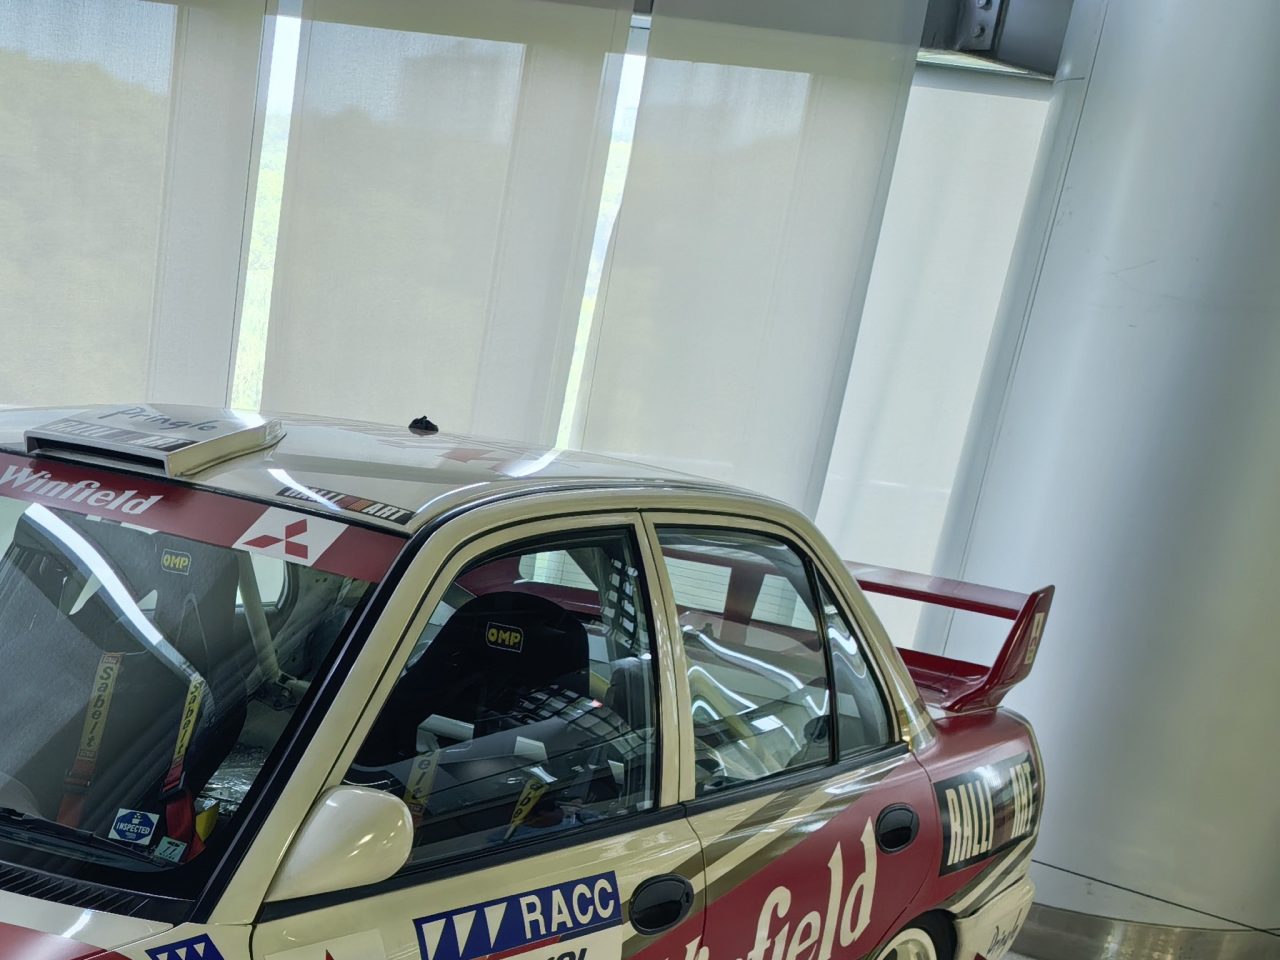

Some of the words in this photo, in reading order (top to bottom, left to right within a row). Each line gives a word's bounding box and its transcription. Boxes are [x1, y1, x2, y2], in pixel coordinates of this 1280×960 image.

[98, 406, 218, 431] Pringle
[163, 553, 189, 570] OMP
[487, 628, 521, 646] OMP
[86, 666, 113, 748] Sabelt
[116, 822, 150, 835] INSPECTED
[945, 777, 994, 866] RALLI
[519, 879, 615, 939] RACC
